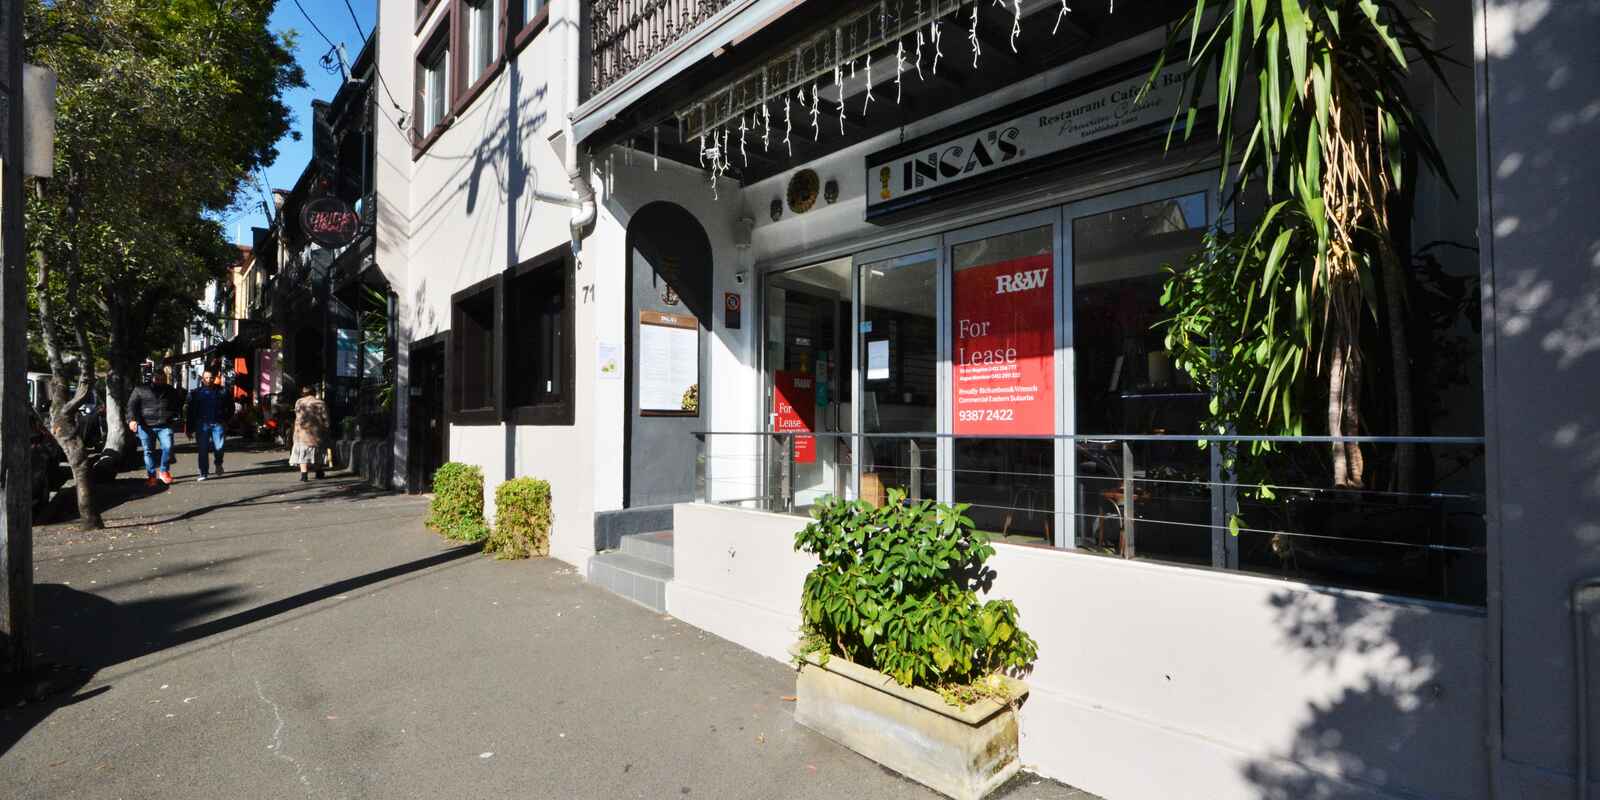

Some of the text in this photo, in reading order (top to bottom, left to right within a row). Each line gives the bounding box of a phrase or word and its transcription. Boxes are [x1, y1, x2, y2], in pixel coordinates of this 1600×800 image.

[1039, 99, 1105, 128] Restaurant
[1163, 70, 1189, 86] Bar
[903, 126, 1020, 191] INCA'S
[995, 268, 1049, 294] R&W
[582, 283, 595, 304] 71
[959, 319, 990, 339] For
[959, 346, 1017, 367] Lease
[779, 402, 792, 413] For
[959, 408, 1014, 421] 9387 2422
[779, 417, 801, 428] Lease
